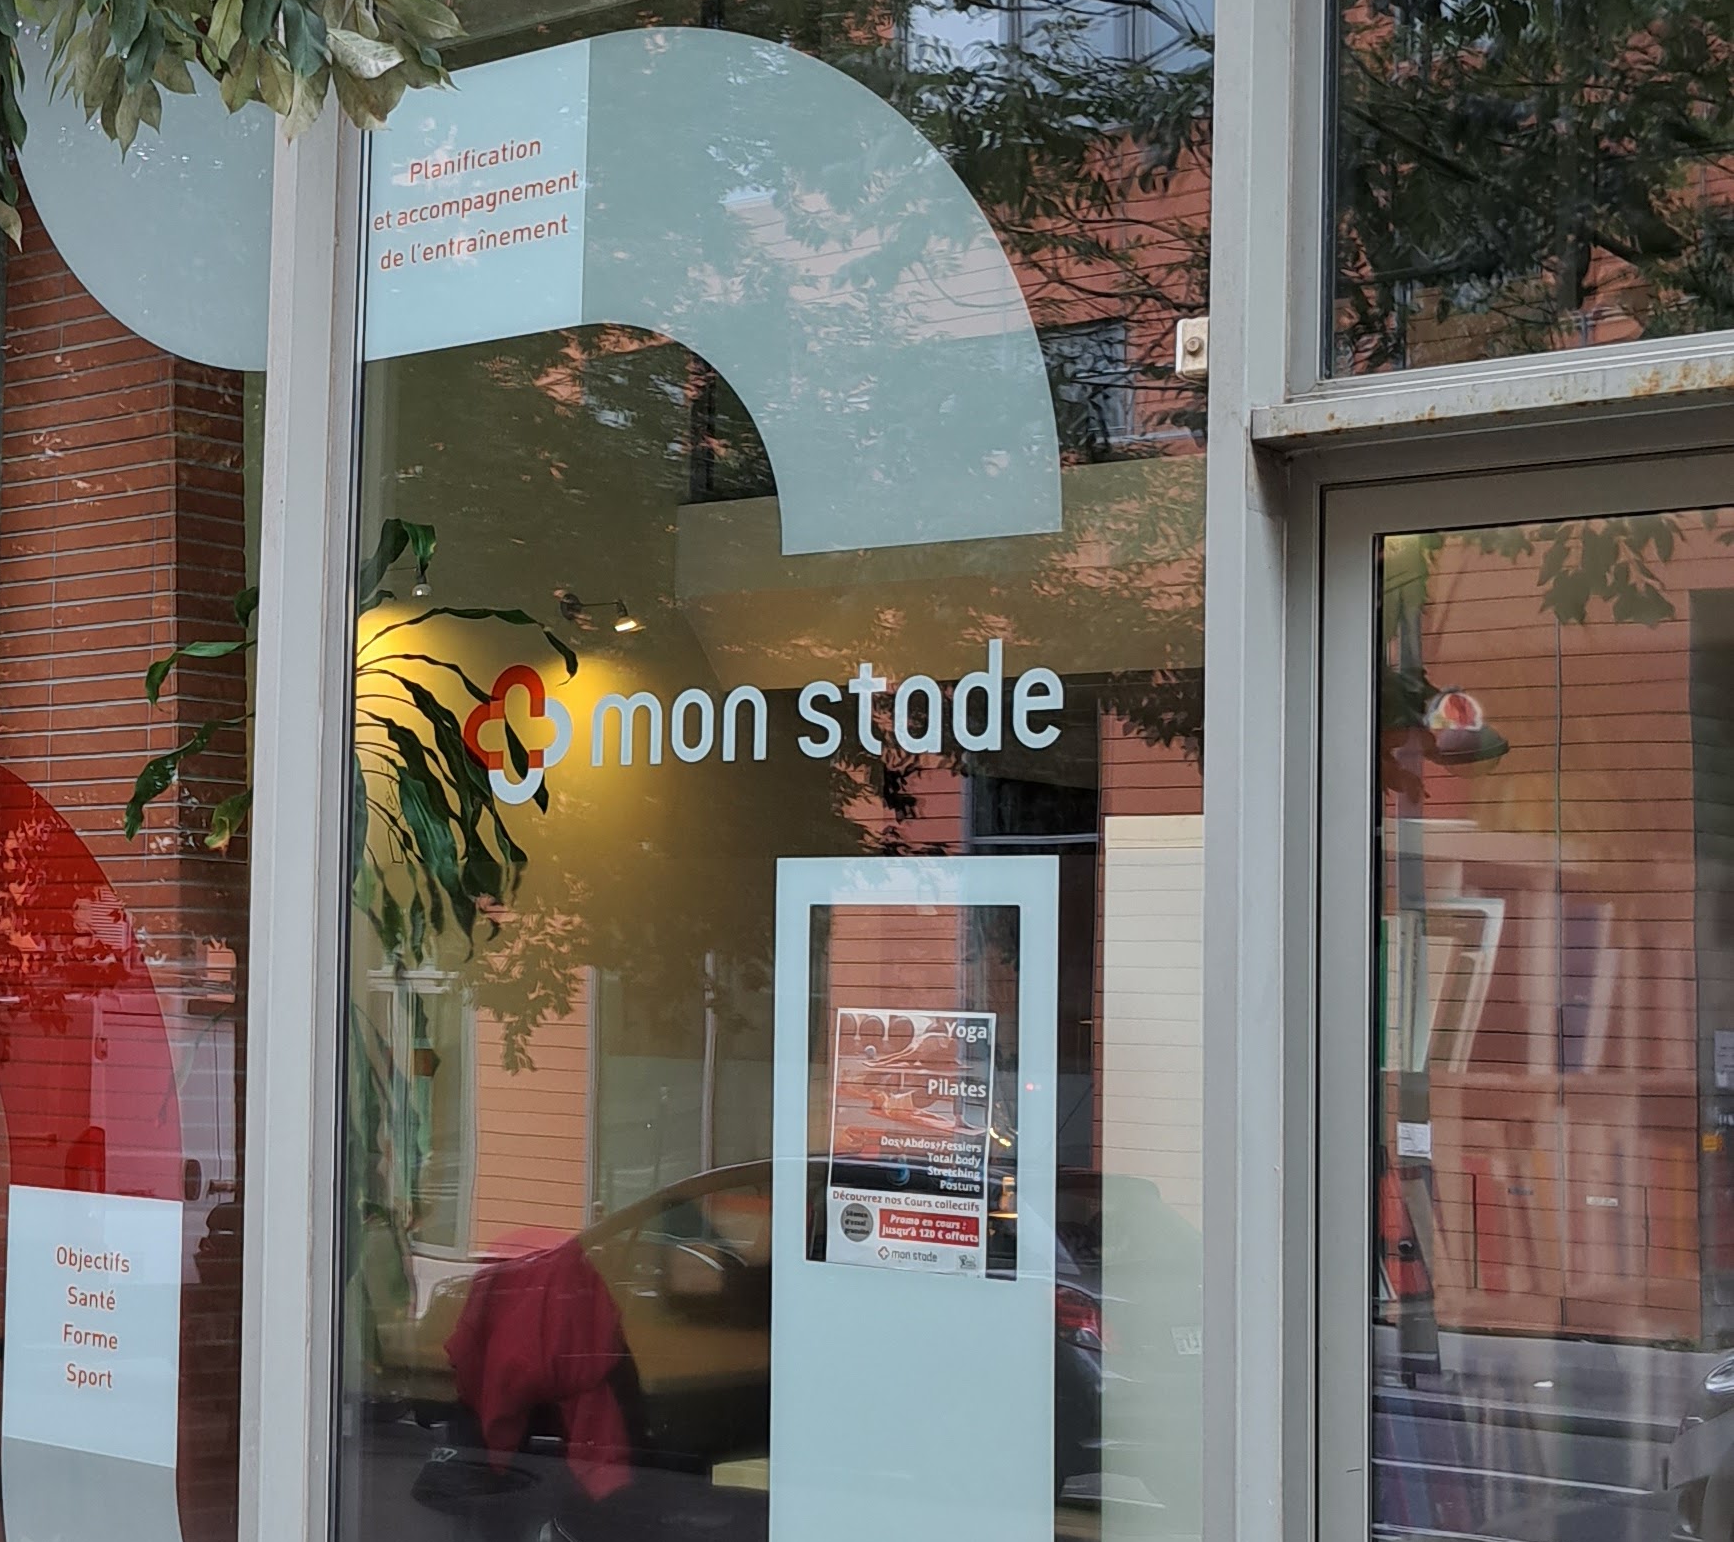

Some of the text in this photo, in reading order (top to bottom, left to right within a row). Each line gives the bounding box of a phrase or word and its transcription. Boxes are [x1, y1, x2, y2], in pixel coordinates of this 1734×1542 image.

[409, 137, 542, 183] Planification
[373, 170, 579, 231] et accompagnement
[380, 214, 569, 270] de l'entraînement
[591, 639, 1065, 768] mon stade
[945, 1021, 987, 1043] Yoga
[927, 1079, 987, 1098] Pilates
[927, 1153, 982, 1168] Total body
[927, 1166, 981, 1181] Stretching
[940, 1180, 981, 1192] Posture
[832, 1190, 980, 1212] Découvrez nos Cours collectifs
[889, 1214, 920, 1226] Promo
[922, 1219, 933, 1227] en
[935, 1221, 961, 1230] cours
[945, 1230, 979, 1243] offerts
[55, 1246, 131, 1275] Objectifs
[891, 1249, 938, 1262] mon stade
[67, 1287, 116, 1311] Santé
[63, 1324, 118, 1350] Forme
[66, 1363, 113, 1388] Sport
